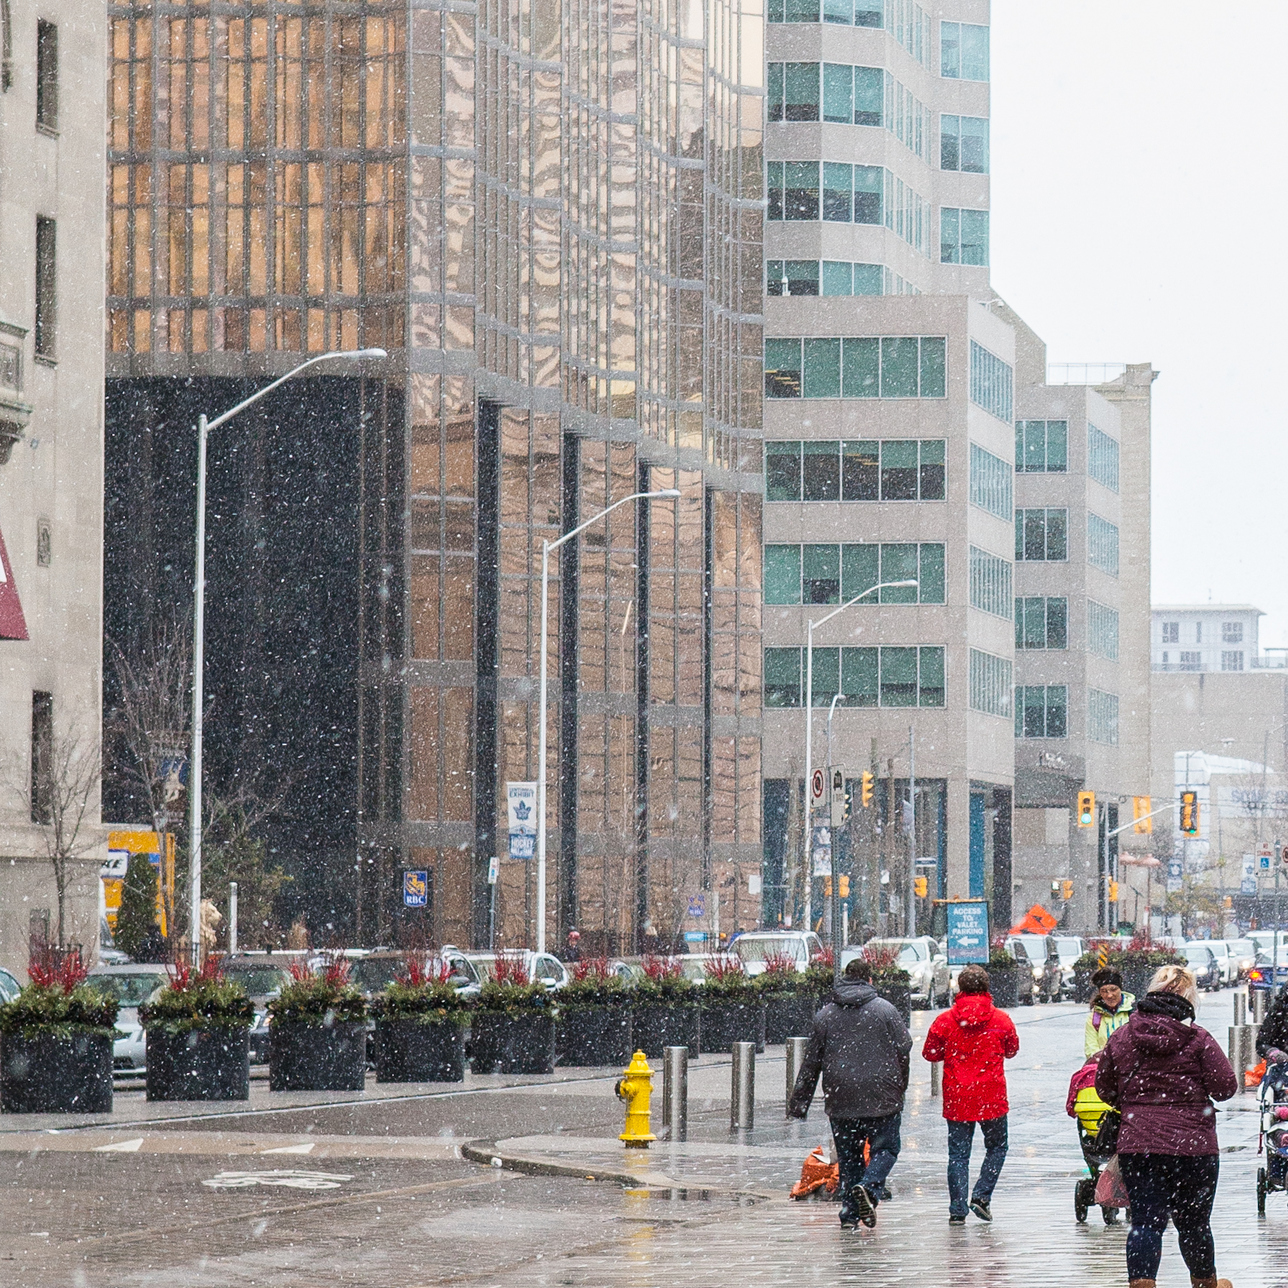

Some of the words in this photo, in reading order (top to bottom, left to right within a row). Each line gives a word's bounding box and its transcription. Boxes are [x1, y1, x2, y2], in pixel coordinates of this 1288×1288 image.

[406, 895, 425, 904] RBC
[953, 907, 982, 915] ACCESS
[957, 921, 979, 929] VALET
